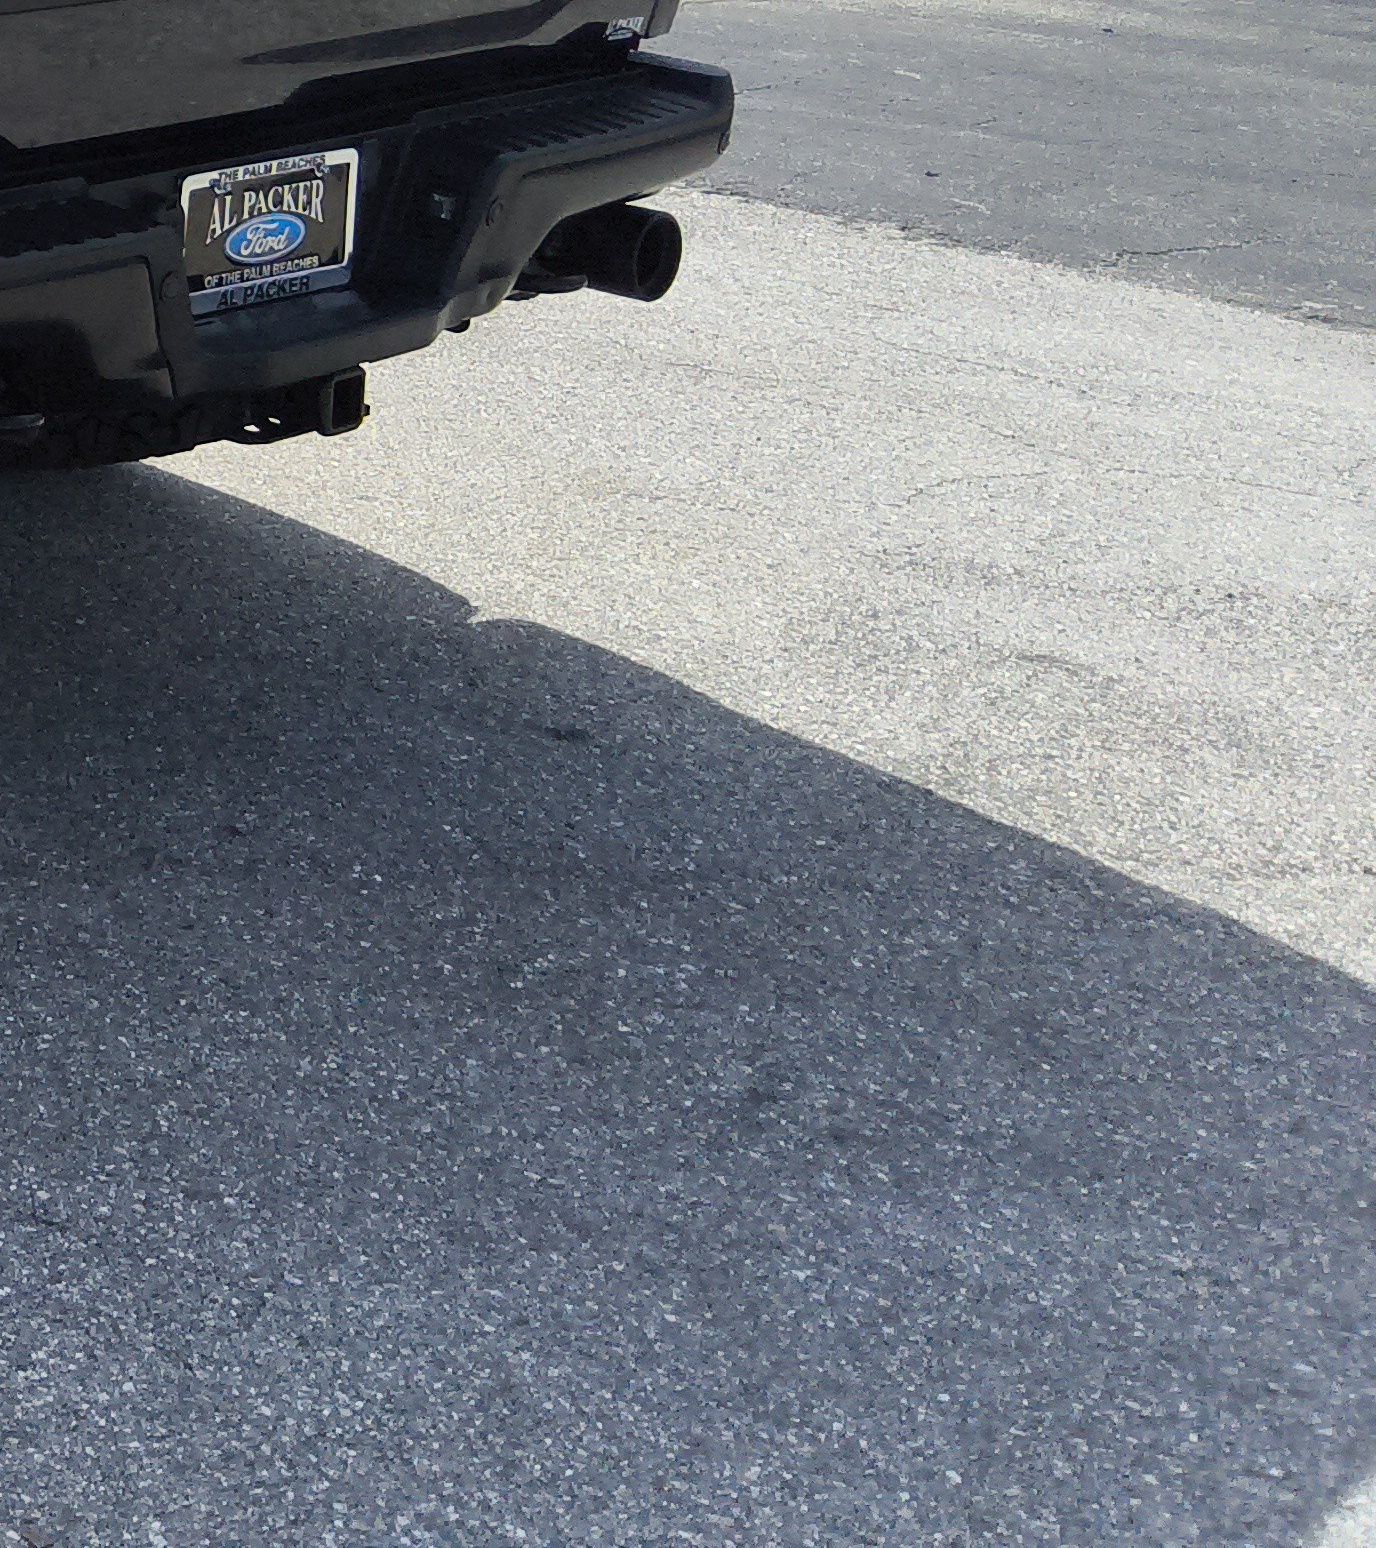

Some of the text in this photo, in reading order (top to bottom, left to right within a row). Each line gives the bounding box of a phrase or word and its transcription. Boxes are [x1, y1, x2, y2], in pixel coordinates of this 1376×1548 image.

[217, 154, 327, 183] THE PALM BEACHES
[205, 178, 325, 245] AL PACKER
[240, 222, 290, 256] Ford
[204, 255, 320, 289] OF THE PALM BEACHES
[216, 275, 311, 310] AL PACKER
